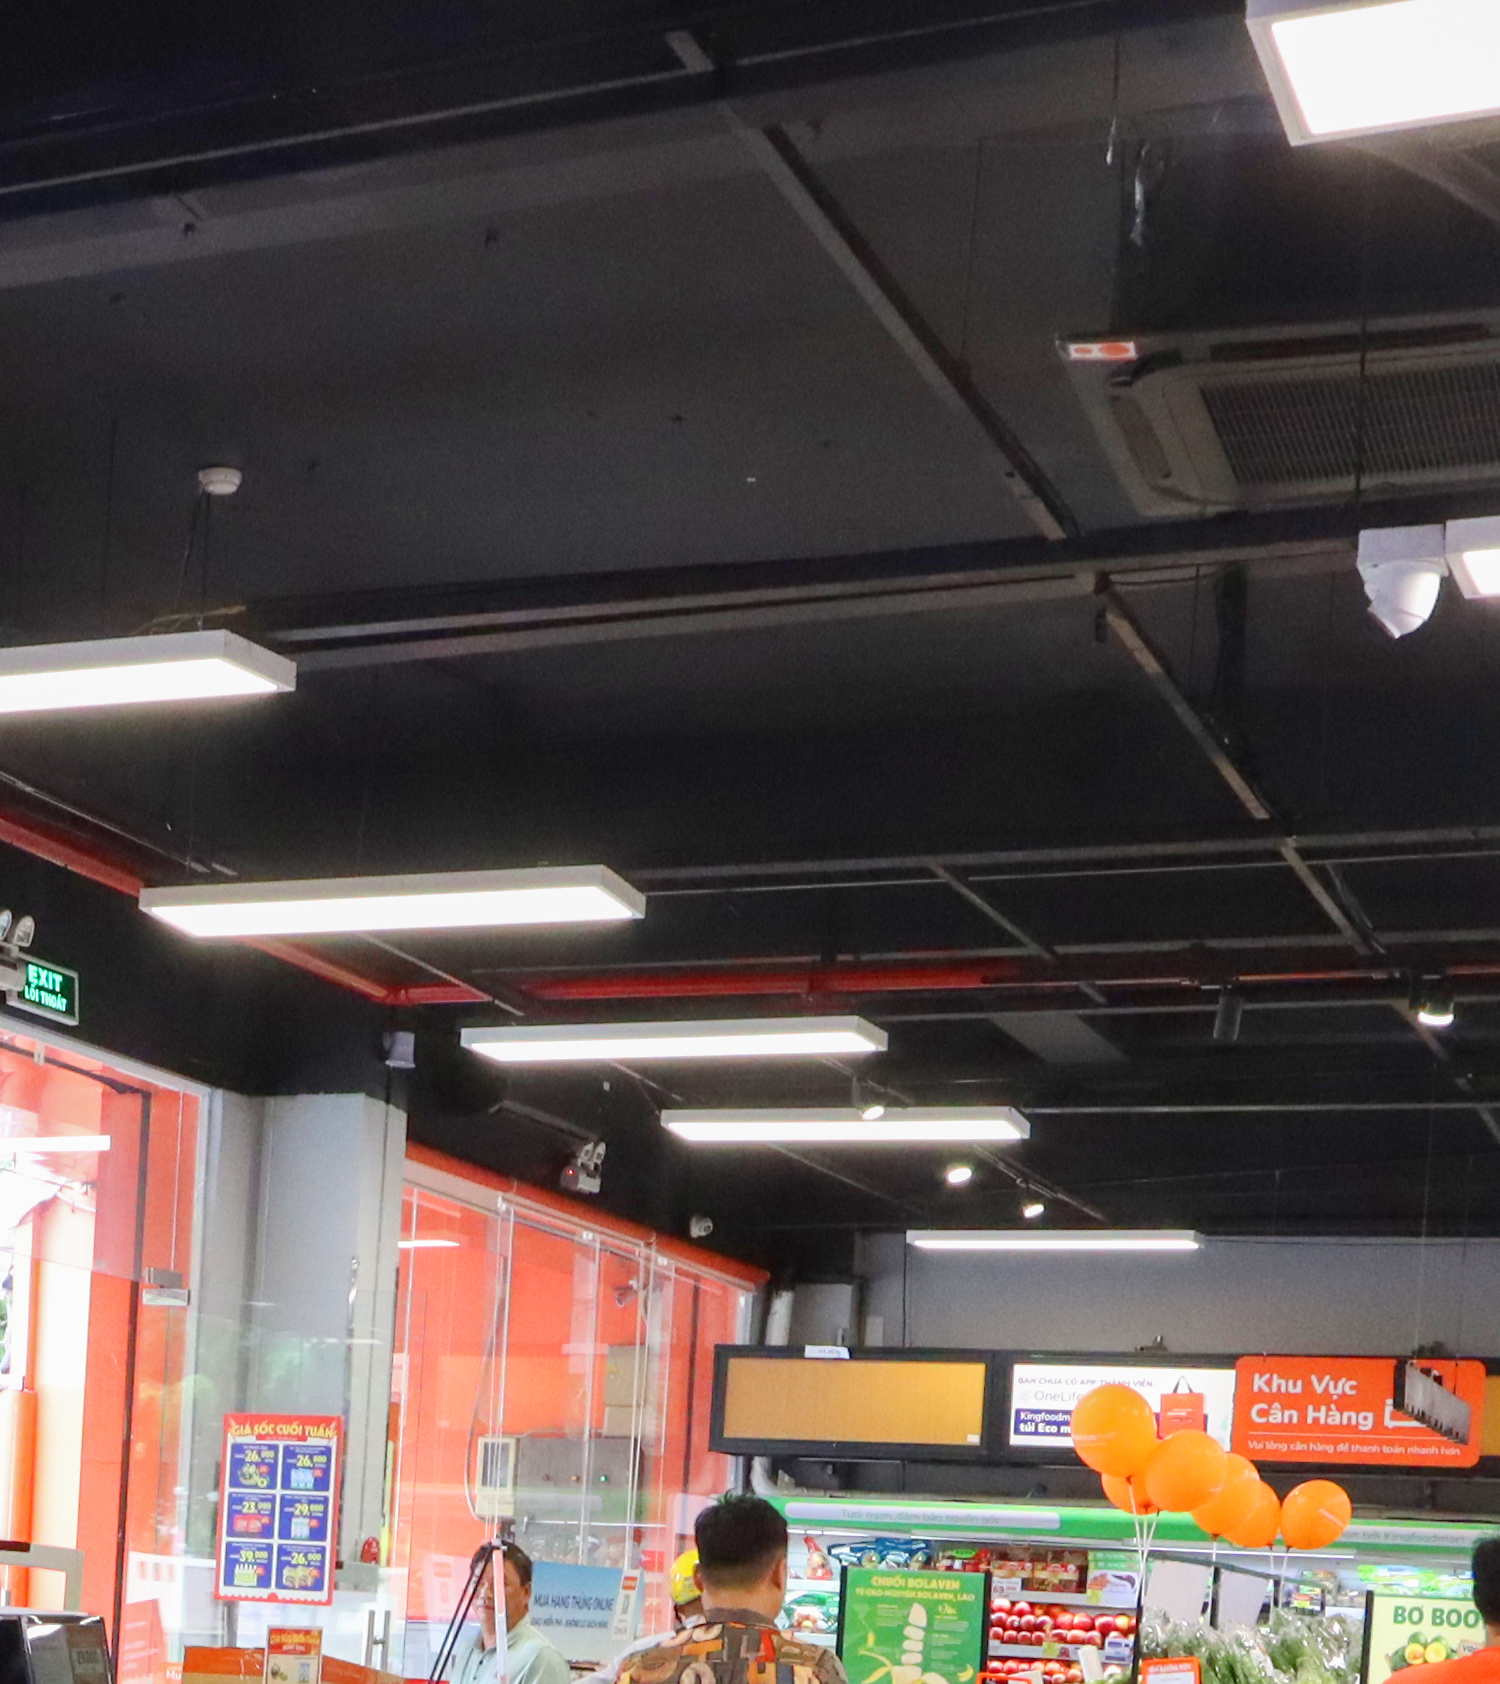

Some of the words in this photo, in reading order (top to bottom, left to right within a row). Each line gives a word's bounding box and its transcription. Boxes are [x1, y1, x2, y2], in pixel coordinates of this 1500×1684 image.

[28, 963, 63, 992] EXIT
[40, 991, 67, 1012] THOÁT
[1251, 1372, 1305, 1396] Khu
[1309, 1373, 1358, 1399] Vực
[1250, 1397, 1299, 1426] Cân
[1305, 1398, 1375, 1433] Hàng
[1019, 1421, 1036, 1434] túi
[1037, 1422, 1058, 1434] Eco
[1247, 1440, 1263, 1452] Vui
[1265, 1439, 1287, 1455] lòng
[1351, 1442, 1379, 1455] thanh
[1406, 1444, 1439, 1456] nhanh
[872, 1574, 905, 1587] CHUỐI
[908, 1578, 961, 1590] BOLAVEN
[1393, 1605, 1424, 1625] BƠ
